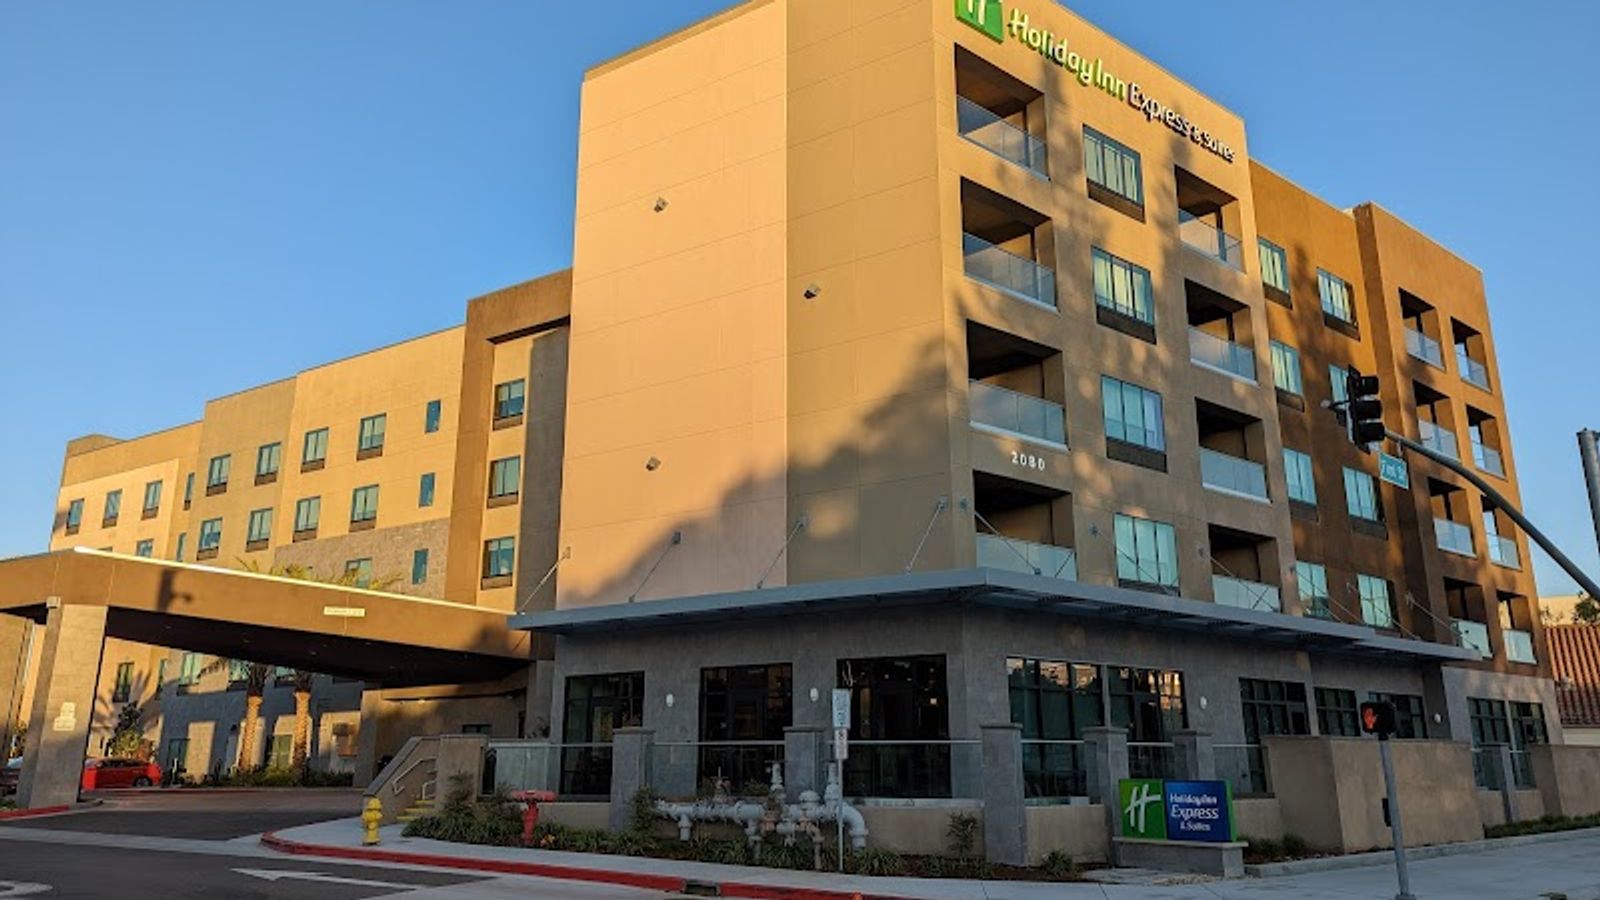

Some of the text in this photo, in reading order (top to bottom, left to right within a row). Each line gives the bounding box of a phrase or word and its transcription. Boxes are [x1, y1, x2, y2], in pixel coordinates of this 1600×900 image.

[1008, 8, 1093, 86] Holiday
[1094, 58, 1126, 100] Inn
[1127, 82, 1191, 137] Express
[1201, 132, 1235, 163] Suites
[1011, 450, 1046, 471] 2080
[1169, 793, 1202, 806] Holiday
[1171, 804, 1219, 821] Express
[1187, 820, 1211, 831] Suites
